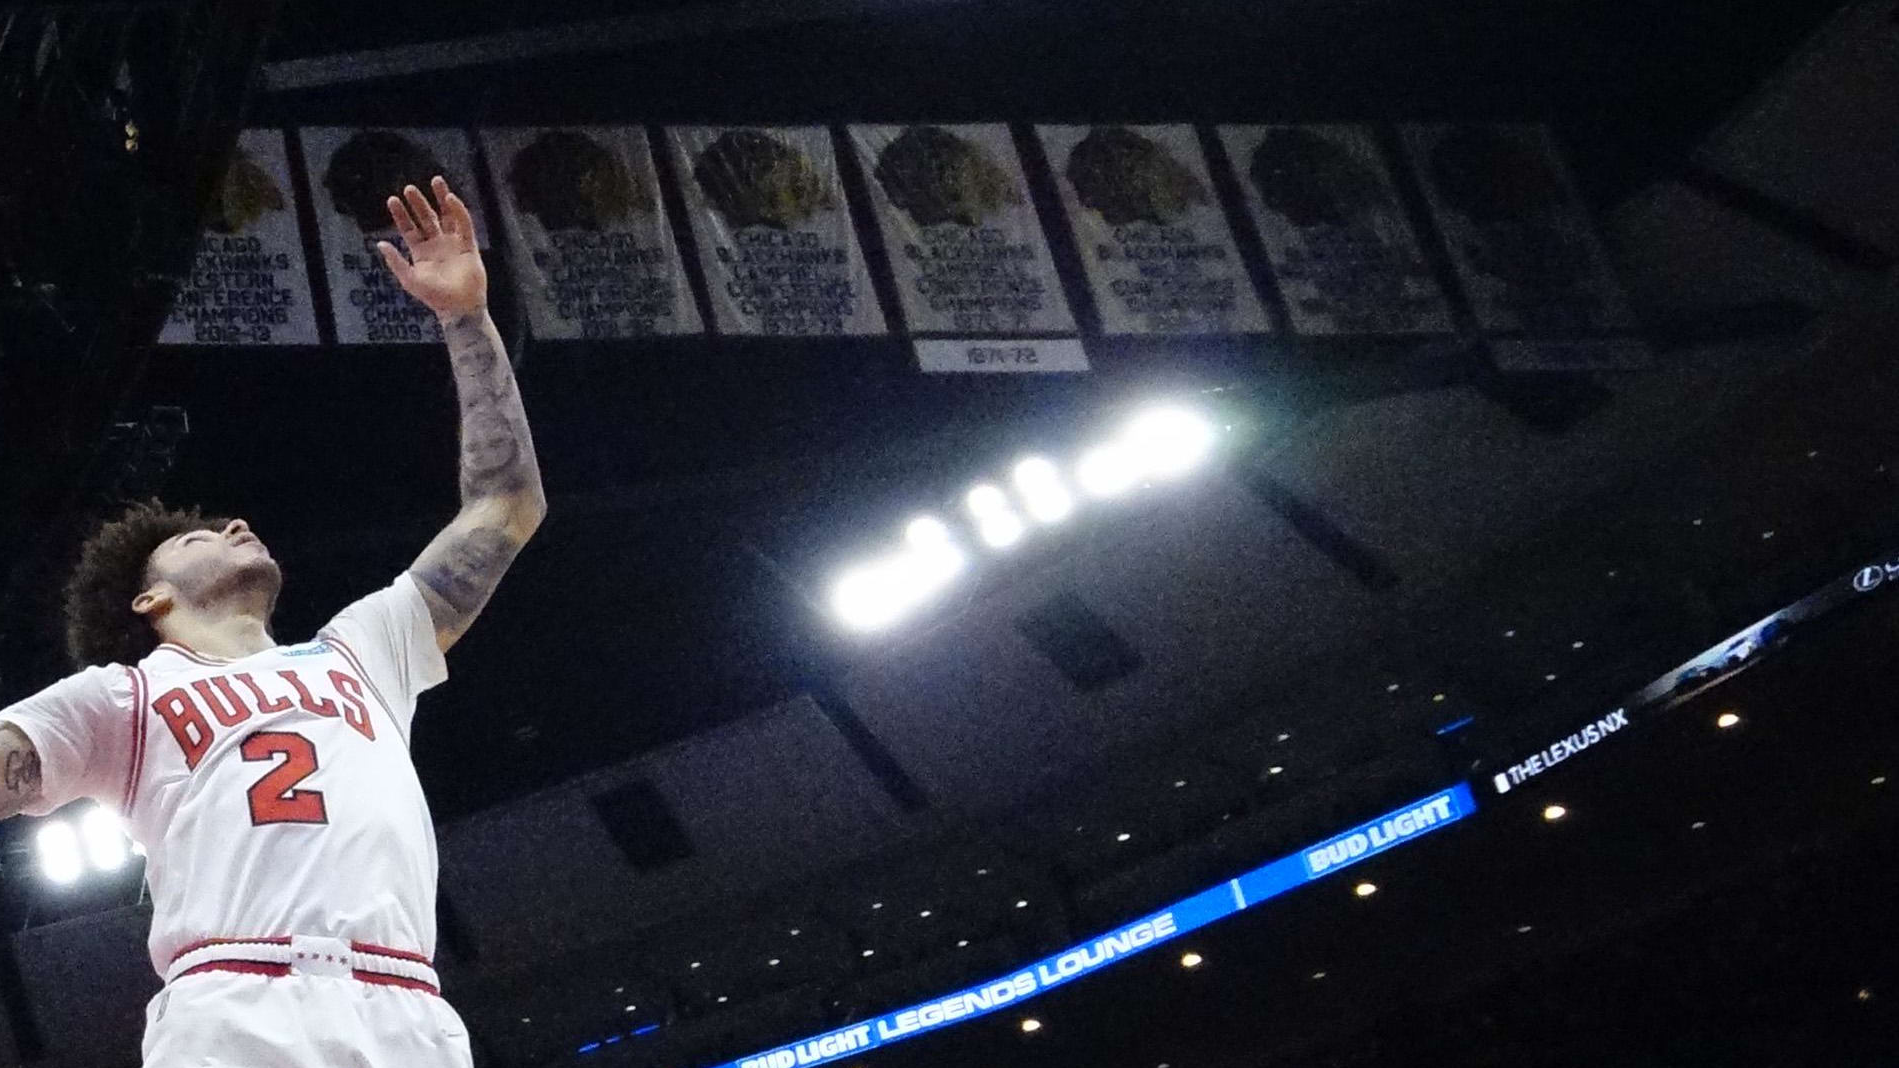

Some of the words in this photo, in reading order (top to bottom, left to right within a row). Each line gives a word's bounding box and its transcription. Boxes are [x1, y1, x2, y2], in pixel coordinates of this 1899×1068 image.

[153, 669, 376, 771] BULLS
[1508, 754, 1546, 784] THE
[1541, 724, 1601, 767] LEXUS
[1597, 708, 1628, 737] NX
[241, 731, 329, 827] 2
[1308, 836, 1367, 873] BUD
[1370, 796, 1451, 848] LIGHT
[796, 1026, 871, 1066] LIGHT
[877, 973, 1036, 1039] LEGENDS
[1039, 913, 1176, 985] LOUNGE
